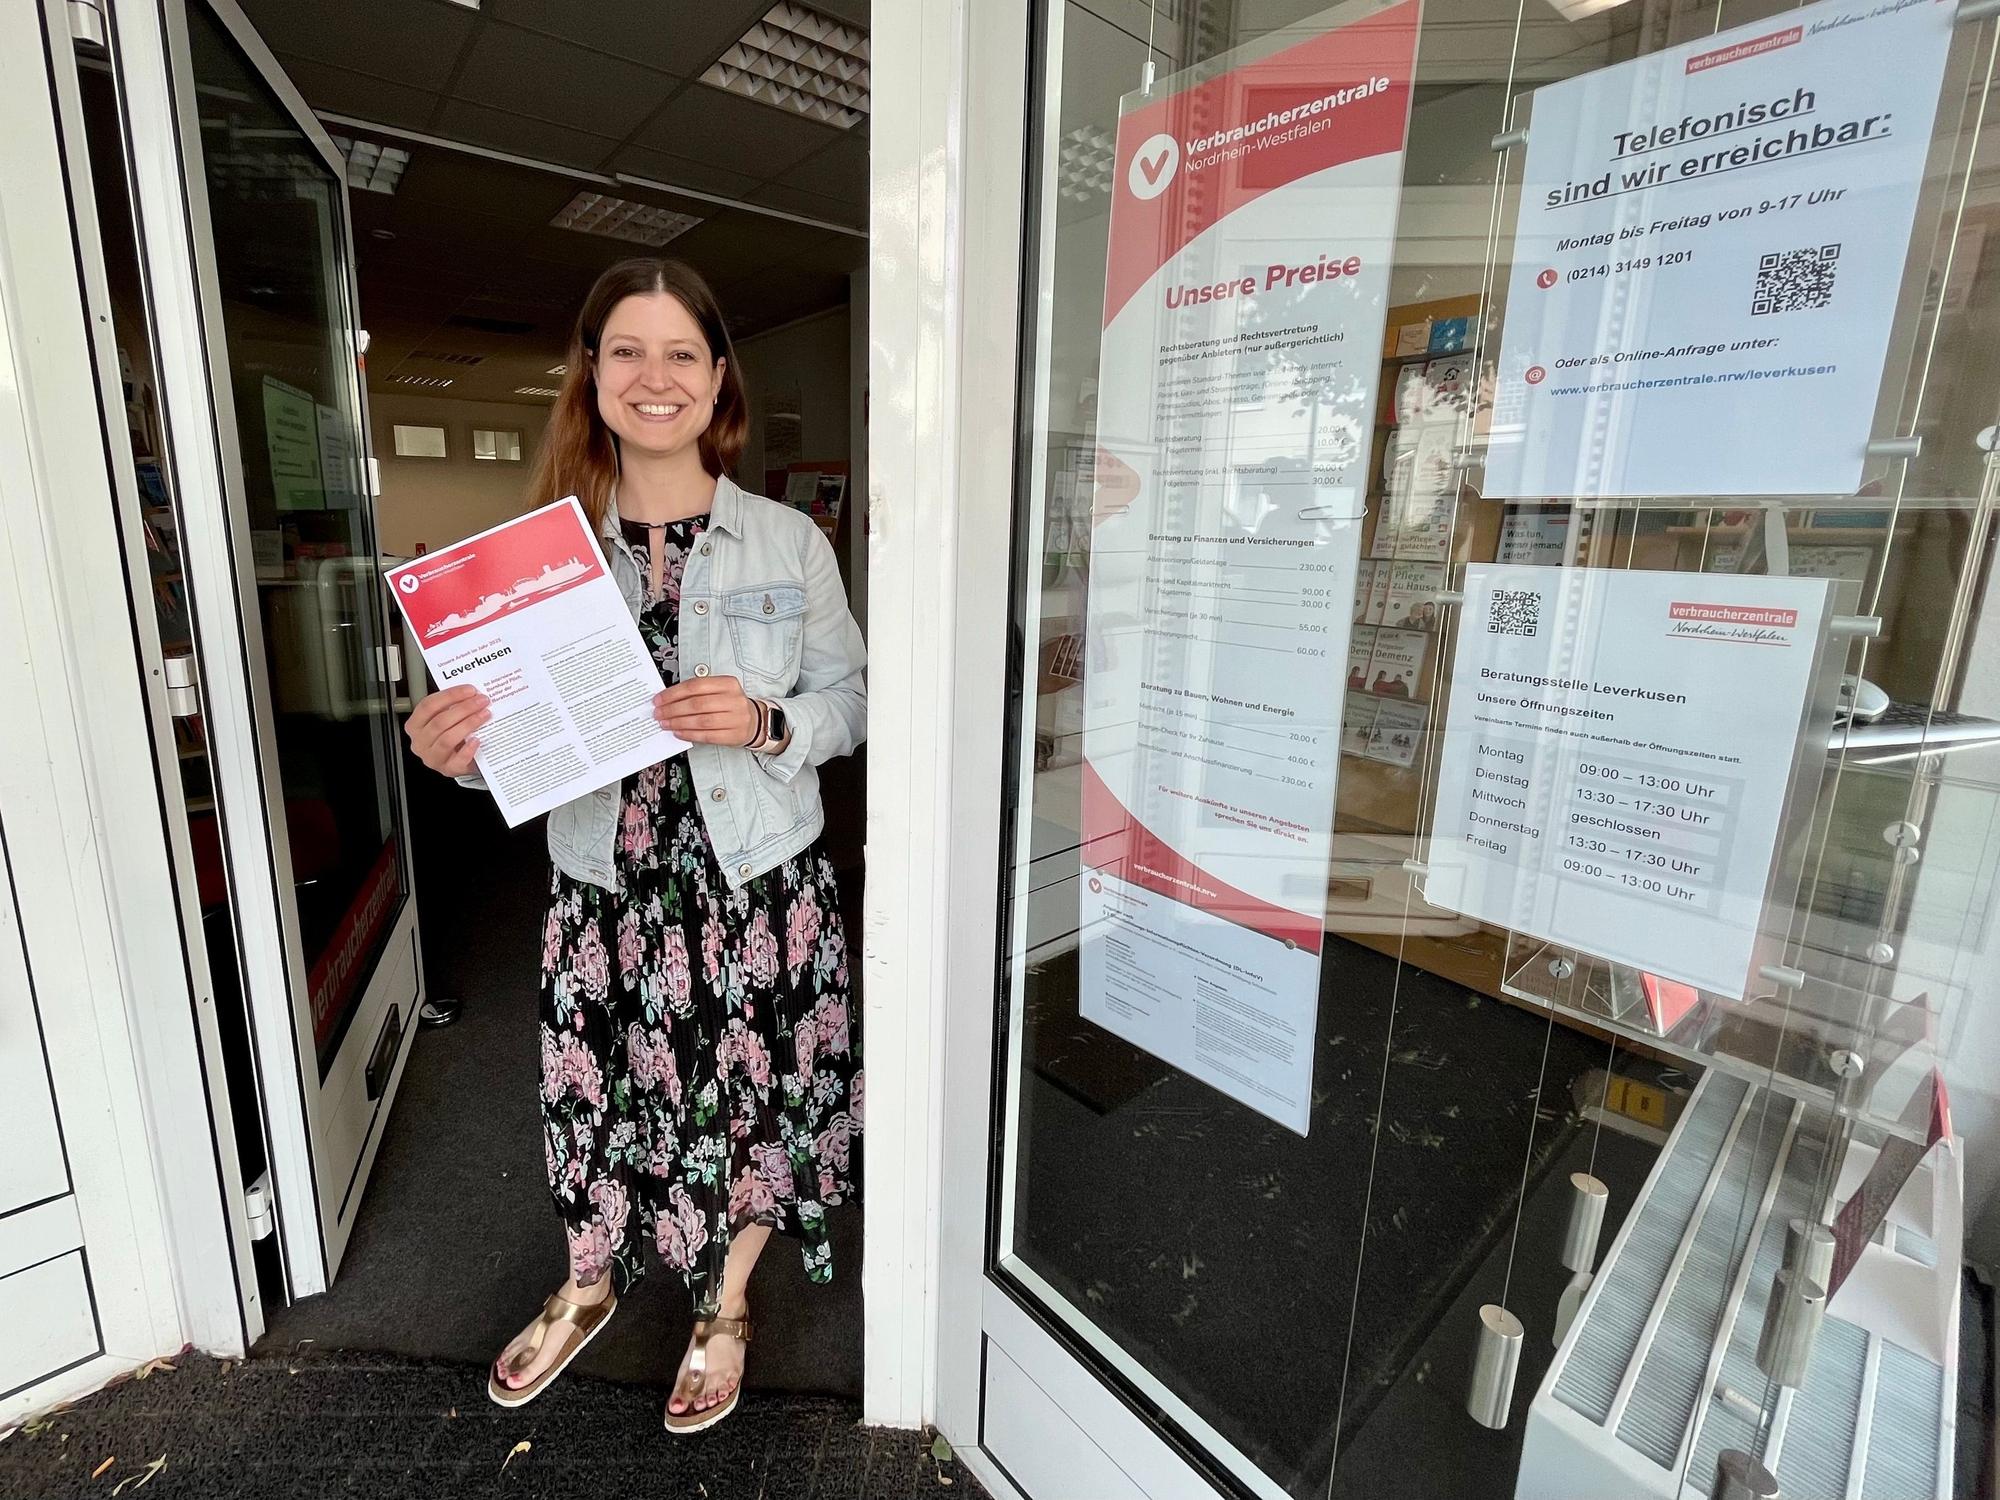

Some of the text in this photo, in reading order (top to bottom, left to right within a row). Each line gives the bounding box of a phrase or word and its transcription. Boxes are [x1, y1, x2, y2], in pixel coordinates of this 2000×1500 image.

[1689, 30, 1799, 71] verbraucherzentrale
[1186, 75, 1389, 156] Verbraucherzentrale
[1614, 88, 1815, 156] Telefonisch
[1185, 117, 1331, 173] Nordrhein-Westfalen
[1547, 113, 1891, 207] sind wir erreichbar:
[1556, 187, 1847, 252] Montag bis Freitag von 9-17 Uhr
[1166, 254, 1360, 309] Unsere Preise
[1566, 250, 1693, 284] (0214) 3149 1201
[1159, 333, 1344, 366] gegenüber Anbietern (nur außergerichtlich)
[1160, 324, 1318, 353] Rechtsberatung und Rechtsvertretung
[1555, 336, 1779, 369] Oder als Online-Anfrage unter:
[1550, 363, 1836, 396] www.verbraucherzentrale.nrw/leverkusen
[1149, 534, 1182, 543] Beratung
[1194, 535, 1227, 544] Finanzen
[1247, 537, 1314, 548] Versicherungen
[1672, 605, 1794, 624] verbraucherzentrale
[443, 646, 511, 680] Leverkusen
[1375, 650, 1414, 662] Demenz
[1141, 682, 1172, 695] Beratung
[1184, 689, 1209, 702] Bauen,
[1211, 695, 1243, 708] Wohnen
[1245, 701, 1260, 711] und
[1263, 704, 1295, 717] Energie
[1481, 668, 1686, 704] Beratungsstelle Leverkusen
[1477, 692, 1614, 722] Unsere Öffnungszeiten
[1544, 725, 1568, 736] finden
[1570, 730, 1589, 740] auch
[1590, 733, 1631, 748] außerhalb
[1633, 740, 1647, 749] der
[1649, 741, 1717, 762] Öffnungszeiten
[1478, 744, 1524, 764] Montag
[1579, 762, 1619, 781] 09:00
[1638, 774, 1680, 793] 13:00
[1685, 783, 1715, 799] Uhr
[1475, 767, 1529, 789] Dienstag
[1576, 788, 1615, 805] 13:30
[1634, 799, 1675, 818] 17:30
[1680, 808, 1710, 825] Uhr
[1269, 815, 1310, 833] Angeboten
[1472, 789, 1661, 840] Mittwoch geschlossen
[1468, 811, 1540, 838] Donnerstag
[1568, 835, 1606, 853] 13:30
[1625, 849, 1666, 868] 17:30
[1671, 858, 1701, 876] Uhr
[1466, 833, 1507, 854] Freitag
[1563, 858, 1602, 877] 09:00
[1620, 873, 1661, 892] 13:00
[1666, 884, 1695, 901] Uhr
